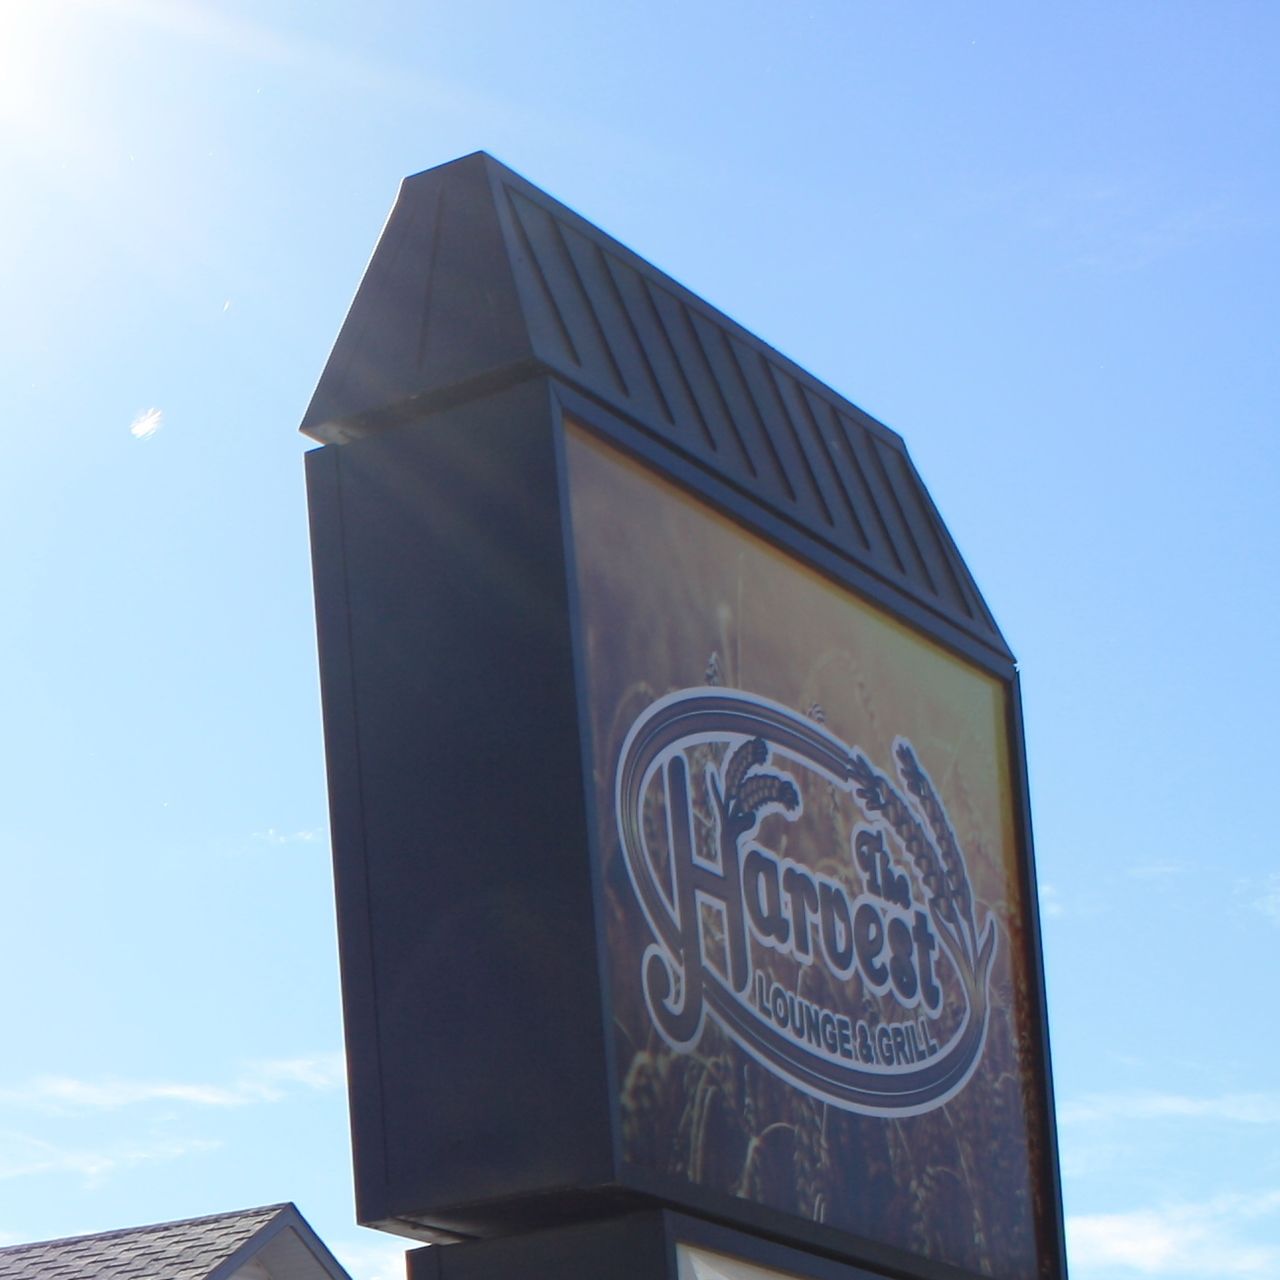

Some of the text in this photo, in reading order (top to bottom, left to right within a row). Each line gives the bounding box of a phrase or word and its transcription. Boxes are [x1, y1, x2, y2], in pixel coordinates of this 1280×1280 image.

[642, 748, 945, 1052] Harvest
[756, 970, 938, 1066] LOUNGE & GRILL
